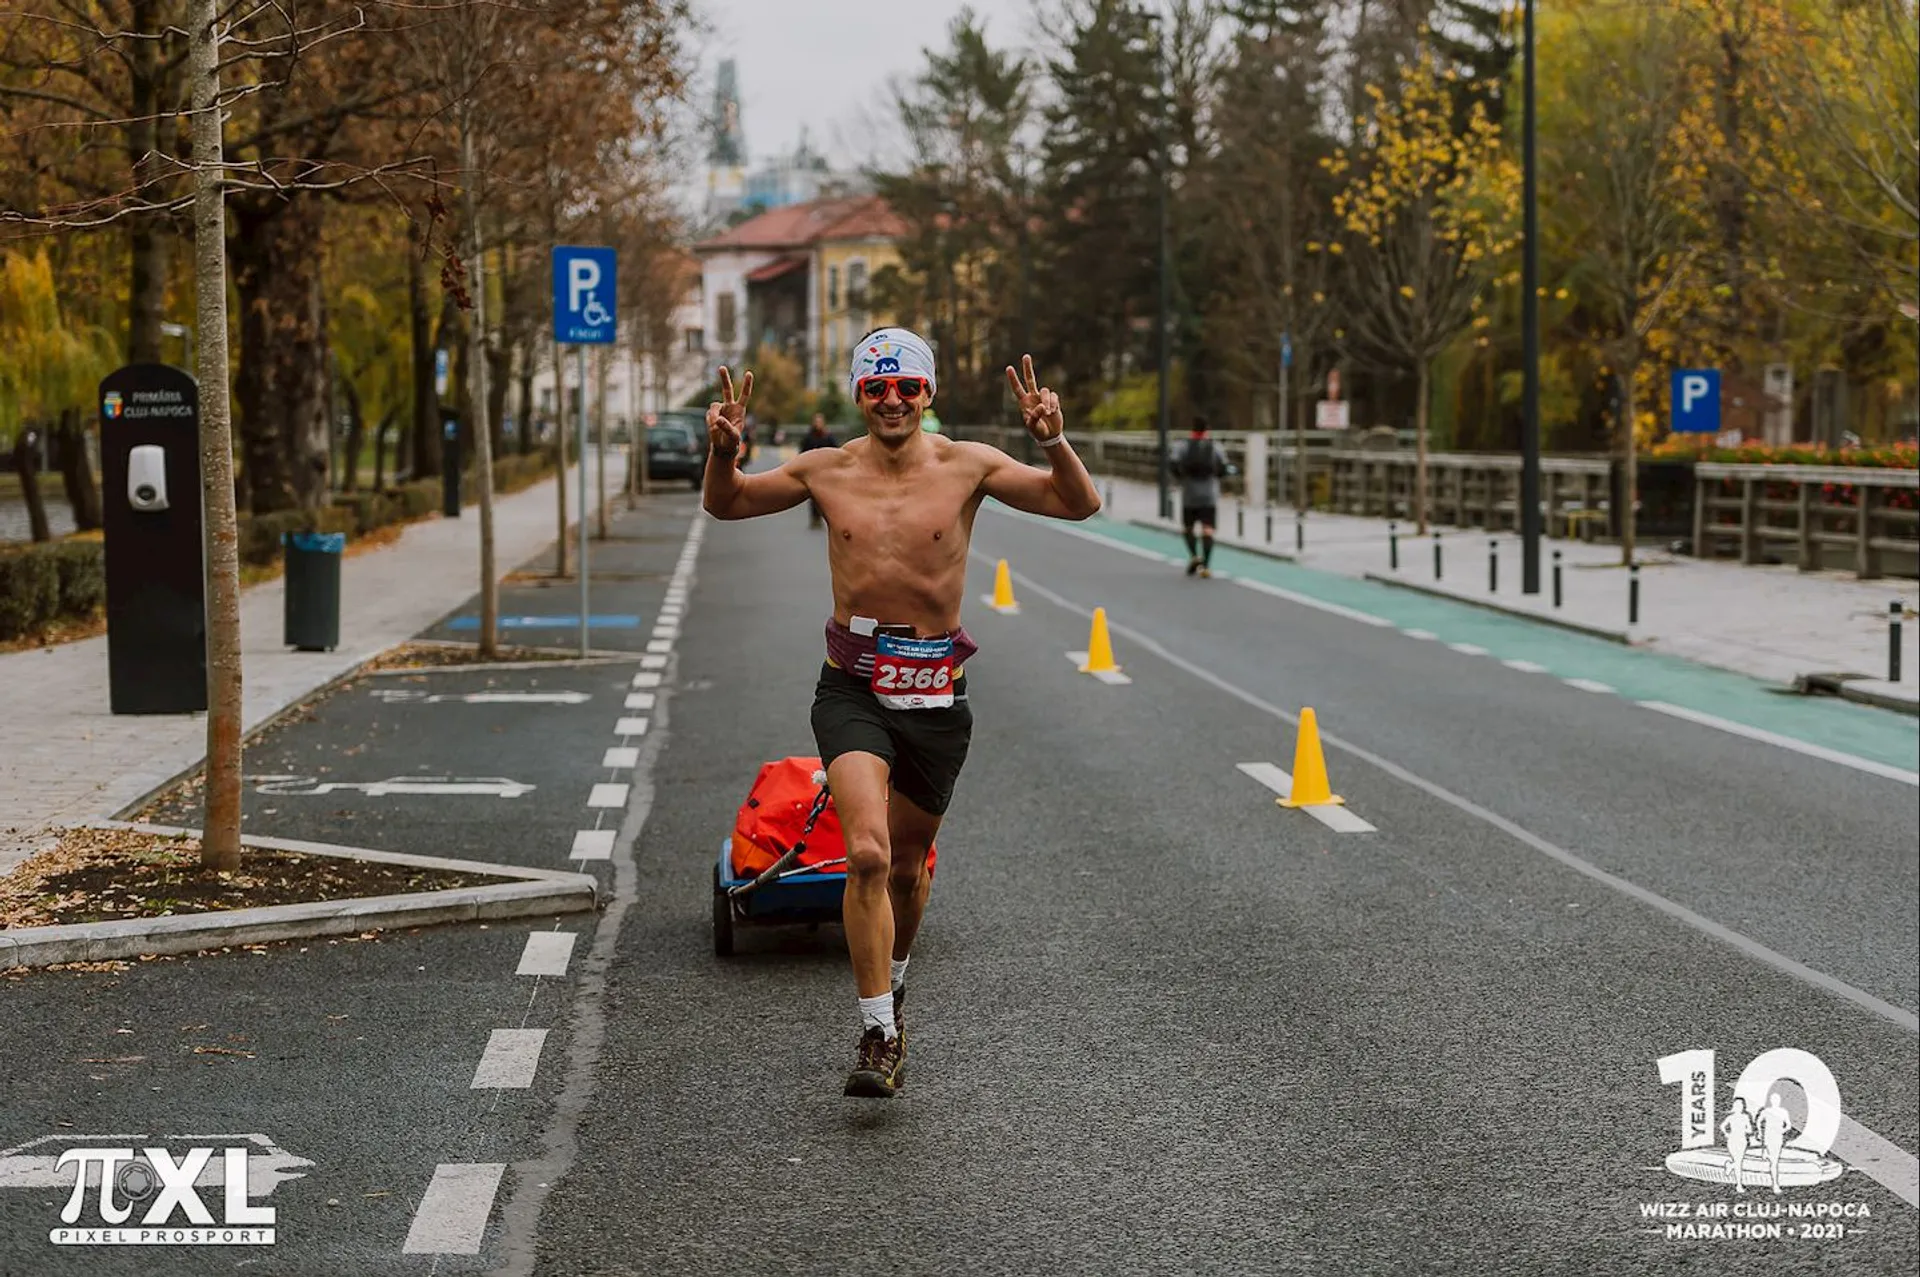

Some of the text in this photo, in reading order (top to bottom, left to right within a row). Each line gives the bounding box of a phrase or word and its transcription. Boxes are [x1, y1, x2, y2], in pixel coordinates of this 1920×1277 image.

[569, 258, 600, 312] P
[1683, 375, 1709, 413] P
[124, 405, 193, 418] CLUJ-NAPOCA
[876, 665, 949, 690] 2366
